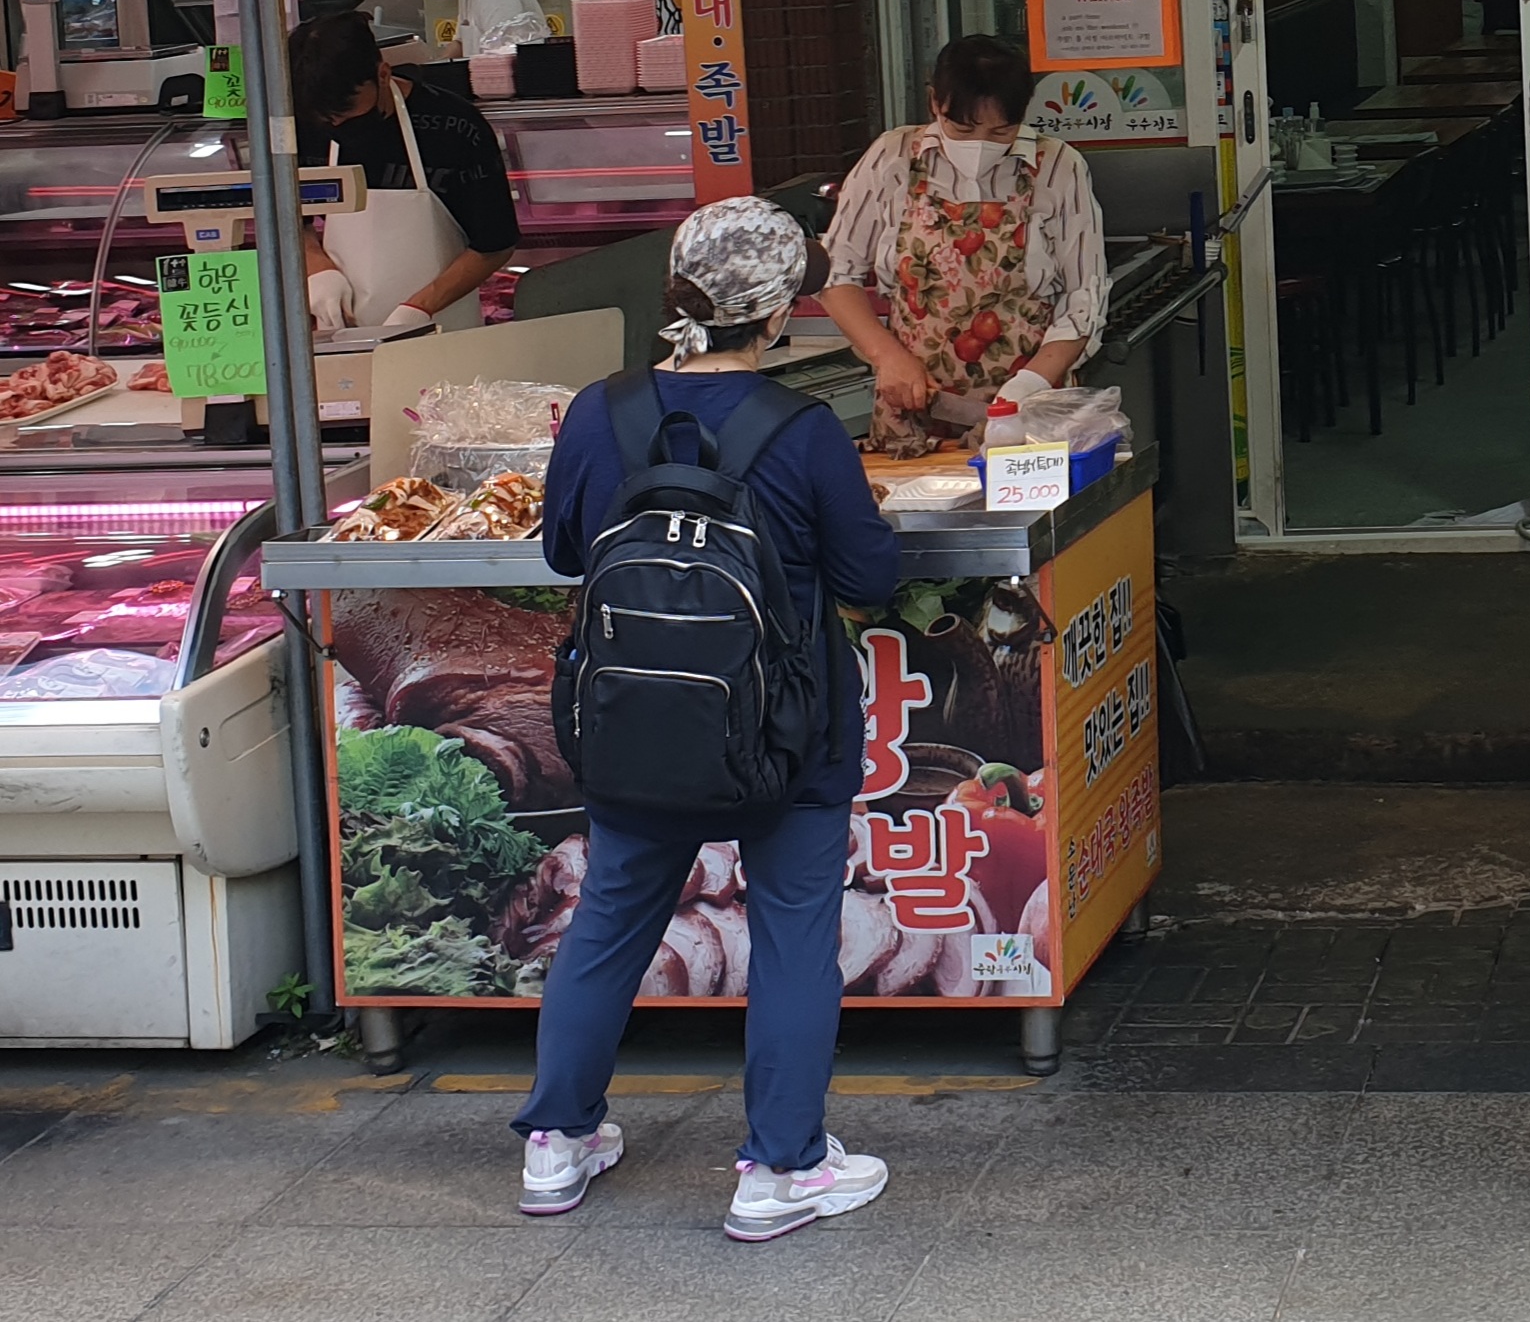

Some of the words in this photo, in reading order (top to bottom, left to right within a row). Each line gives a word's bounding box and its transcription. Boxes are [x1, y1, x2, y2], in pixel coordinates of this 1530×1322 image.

[198, 260, 240, 294] 한우
[1062, 592, 1107, 689] 깨끗한
[1083, 686, 1126, 789] 맛있는
[1076, 802, 1117, 900] 순대국
[1117, 760, 1155, 847] 왕족발
